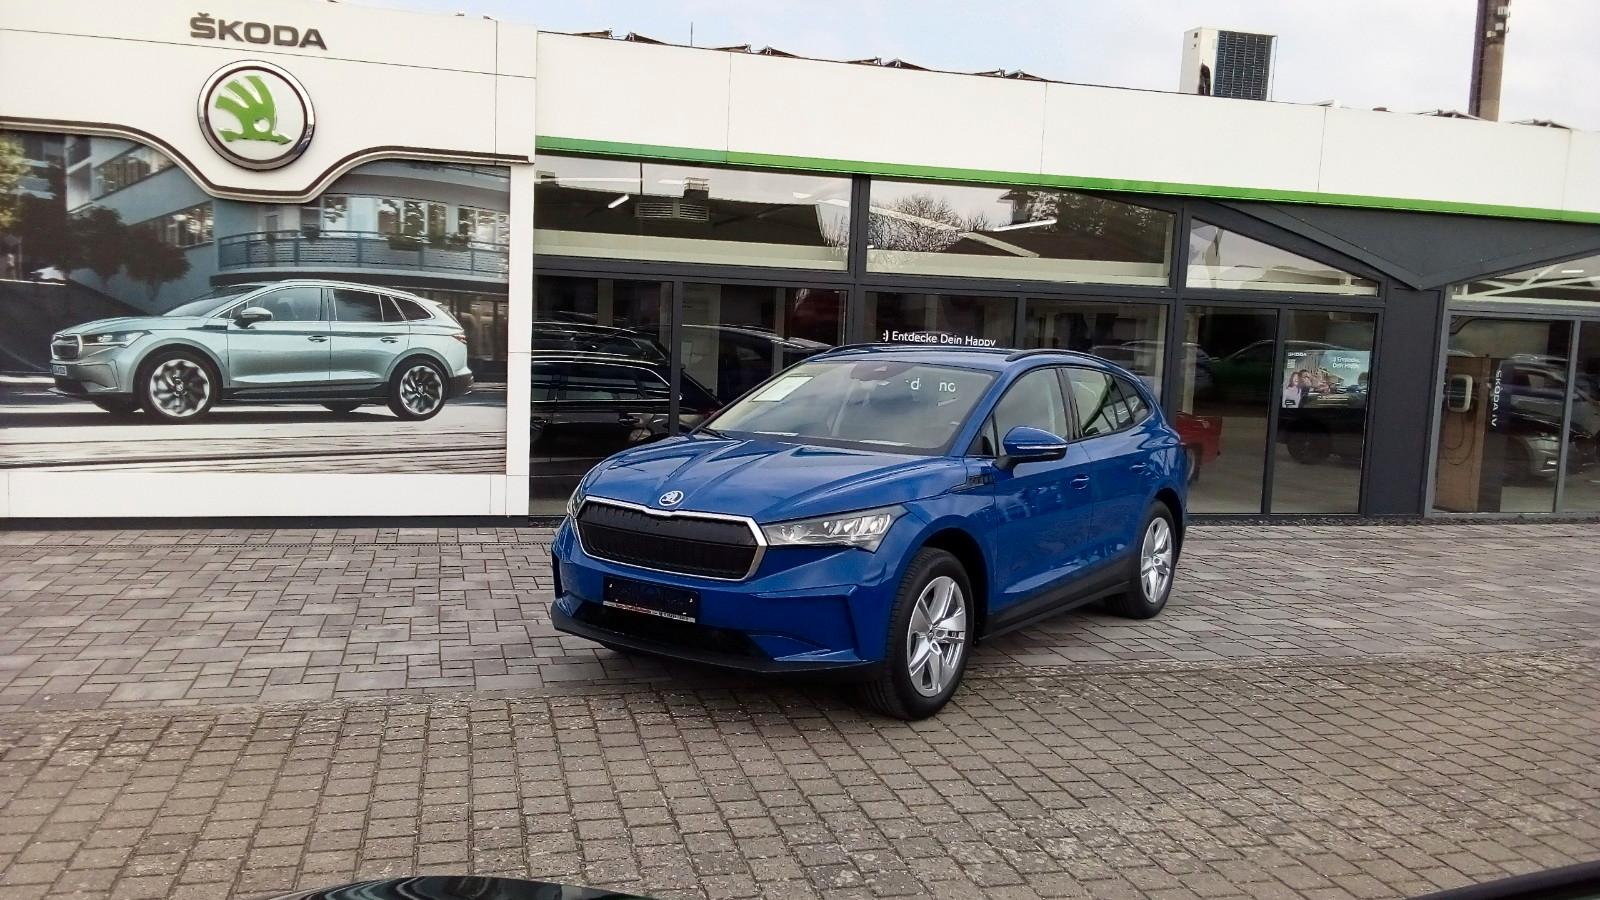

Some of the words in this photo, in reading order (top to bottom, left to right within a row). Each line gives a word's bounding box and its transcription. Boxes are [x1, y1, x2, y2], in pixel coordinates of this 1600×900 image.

[190, 12, 327, 50] ŠKODA
[892, 331, 938, 344] Entdecke
[940, 333, 962, 345] Dein
[965, 335, 997, 347] Happy
